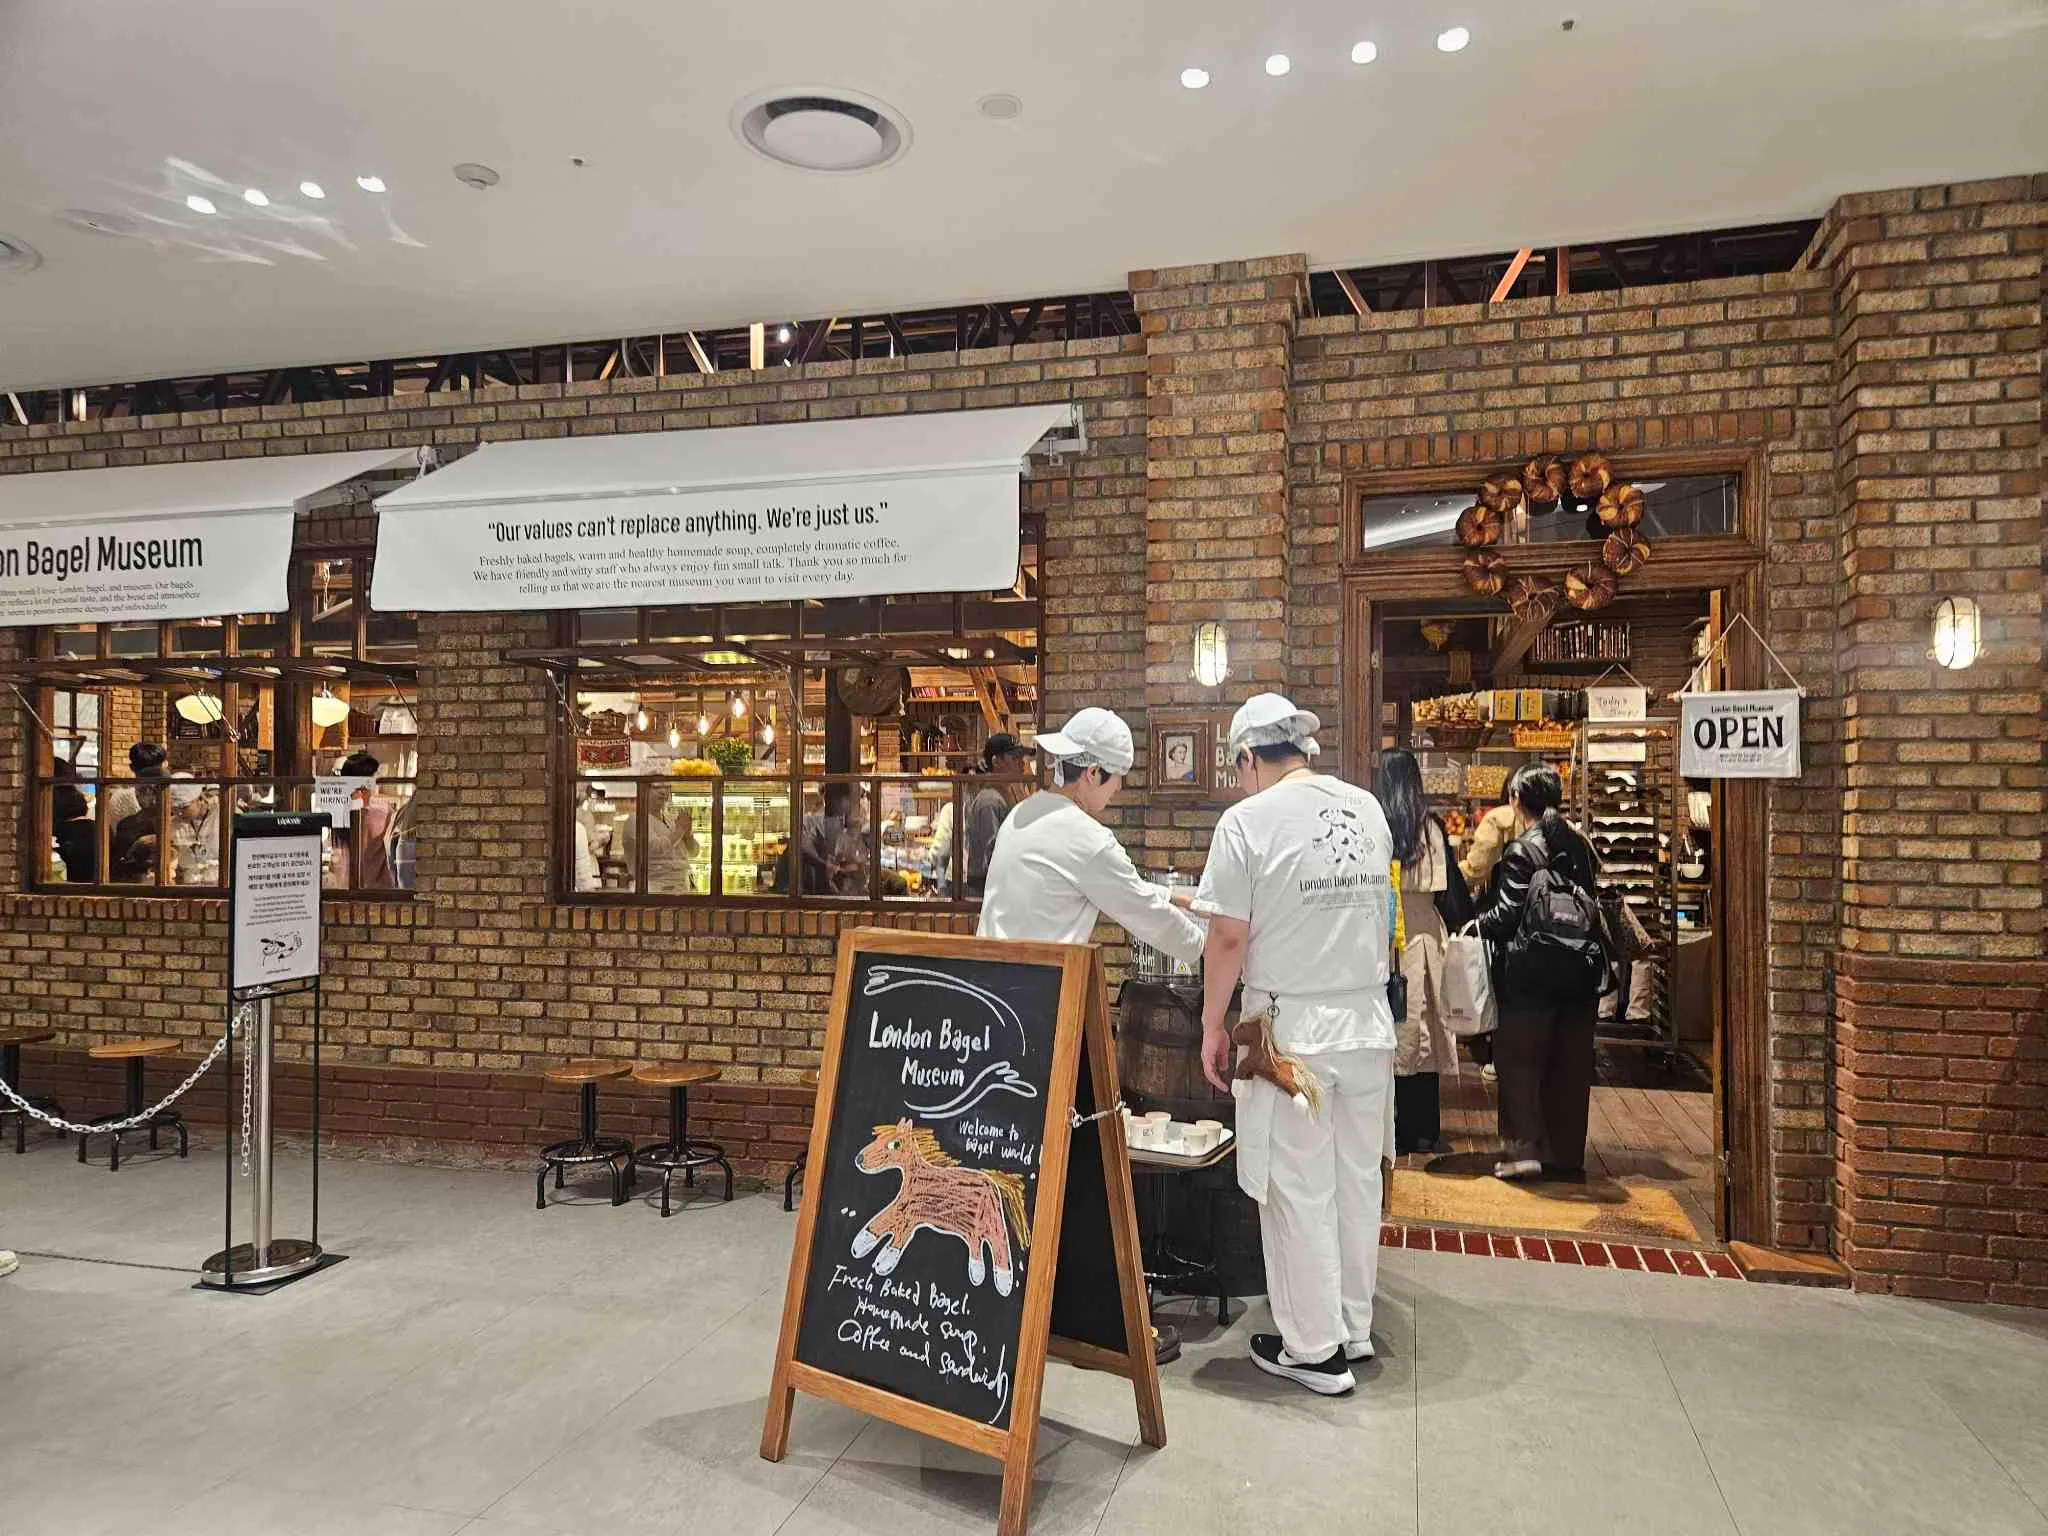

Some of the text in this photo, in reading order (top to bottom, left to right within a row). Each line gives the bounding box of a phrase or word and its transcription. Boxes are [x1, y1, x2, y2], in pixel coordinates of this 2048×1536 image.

[524, 519, 573, 541] values
[620, 512, 680, 539] replace
[685, 509, 762, 537] anything.
[813, 503, 850, 531] just
[27, 536, 90, 581] Bagel
[97, 535, 203, 572] Museum
[473, 570, 488, 582] We
[490, 569, 513, 581] have
[516, 567, 550, 581] friendly
[551, 566, 569, 578] and
[595, 563, 619, 575] staff
[618, 562, 641, 574] who
[643, 562, 678, 575] always
[680, 562, 709, 574] enjoy
[713, 560, 730, 571] fun
[732, 559, 759, 570] small
[786, 556, 819, 569] Thank
[822, 557, 844, 568] you
[846, 556, 858, 566] so
[860, 553, 891, 564] much
[893, 552, 908, 563] for
[479, 553, 514, 567] Freshly
[517, 552, 543, 565] baked
[578, 551, 606, 561] warm
[609, 549, 626, 560] and
[628, 547, 664, 561] healthy
[667, 544, 723, 558] homemade
[726, 546, 754, 558] soup,
[756, 540, 812, 556] completely
[814, 538, 861, 551] dramatic
[519, 583, 548, 596] telling
[550, 584, 561, 594] us
[563, 582, 579, 592] that
[581, 582, 595, 591] we
[613, 579, 628, 590] the
[631, 577, 666, 590] nearest
[668, 576, 711, 588] museum
[715, 576, 735, 589] you
[737, 574, 761, 586] want
[764, 574, 775, 584] to
[778, 572, 799, 584] visit
[802, 572, 832, 585] every
[1693, 715, 1785, 750] OPEN
[1299, 877, 1333, 893] London
[869, 1009, 933, 1051] London
[901, 1055, 965, 1088] Museum
[1008, 1123, 1020, 1141] to
[1001, 1142, 1034, 1166] world
[827, 1264, 874, 1294] Fresh
[879, 1278, 921, 1307] Baked
[837, 1319, 890, 1351] Coffee
[900, 1340, 930, 1368] and
